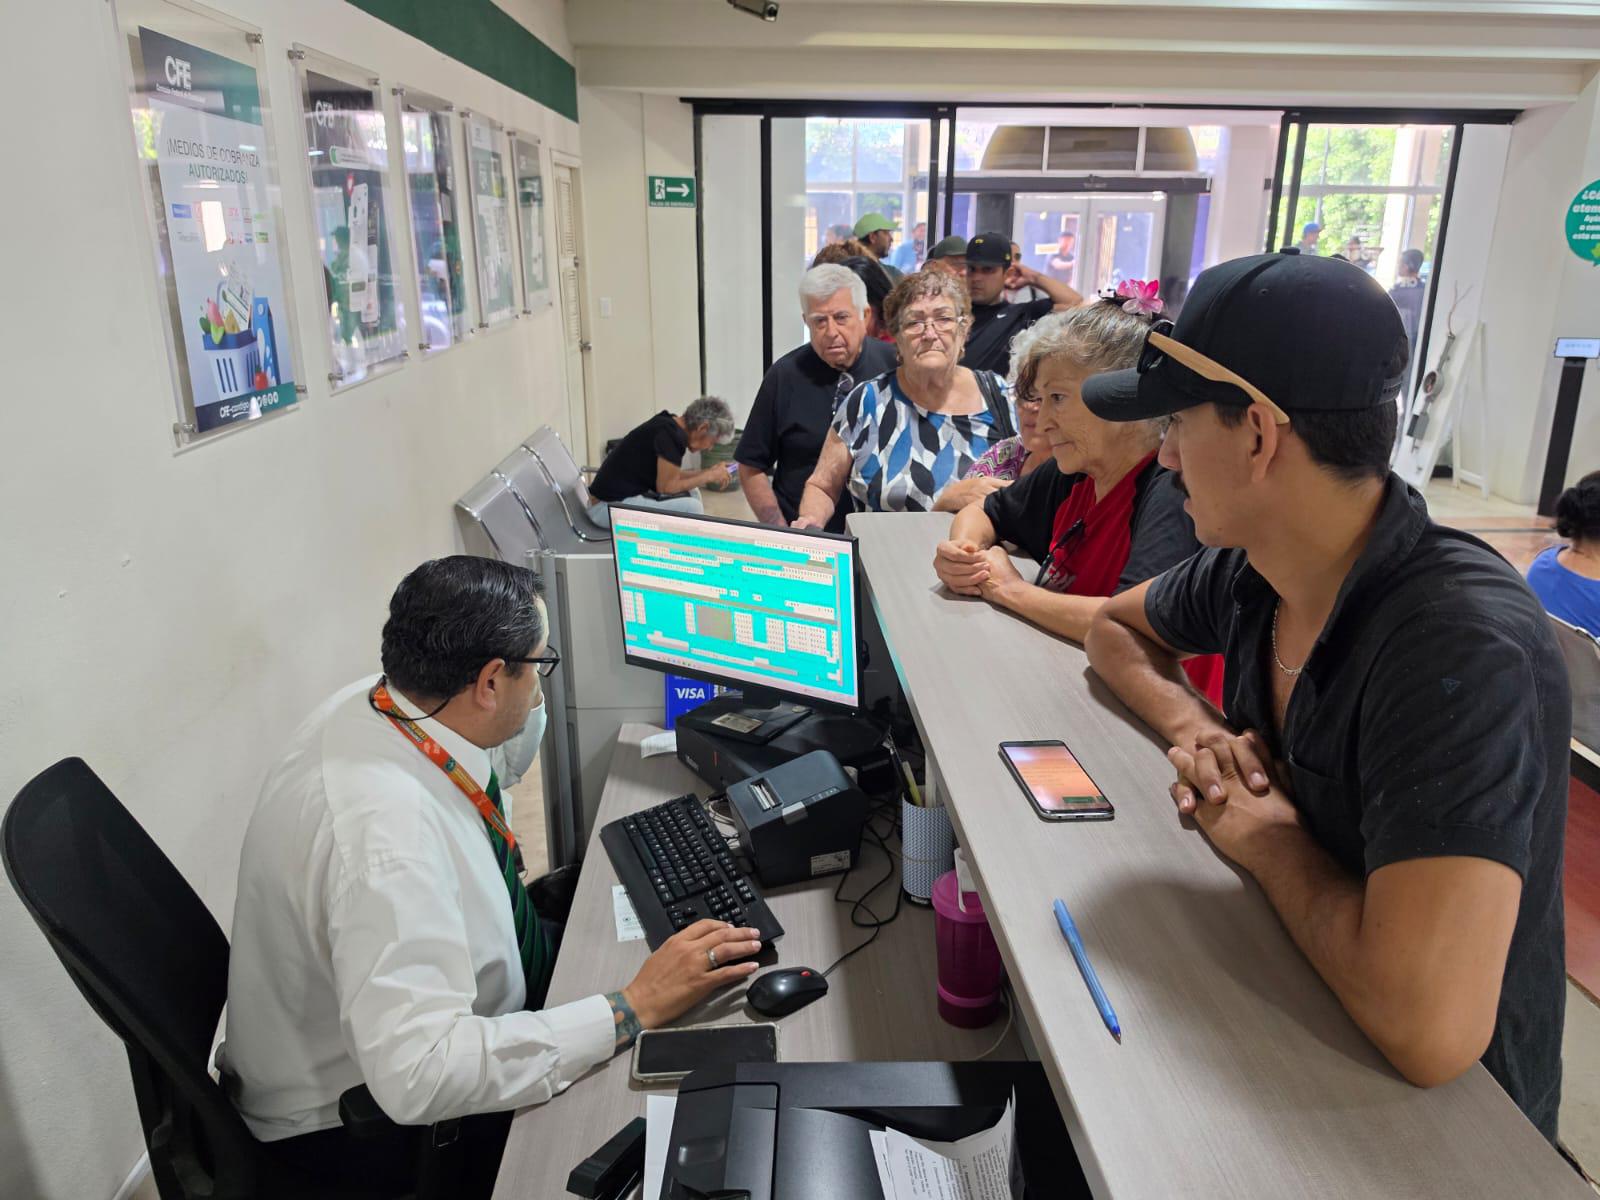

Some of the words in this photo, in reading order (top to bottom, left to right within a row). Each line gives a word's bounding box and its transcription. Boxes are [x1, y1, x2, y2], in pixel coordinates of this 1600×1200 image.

[165, 55, 191, 90] CFE
[206, 145, 217, 160] DE
[674, 687, 705, 700] VISA
